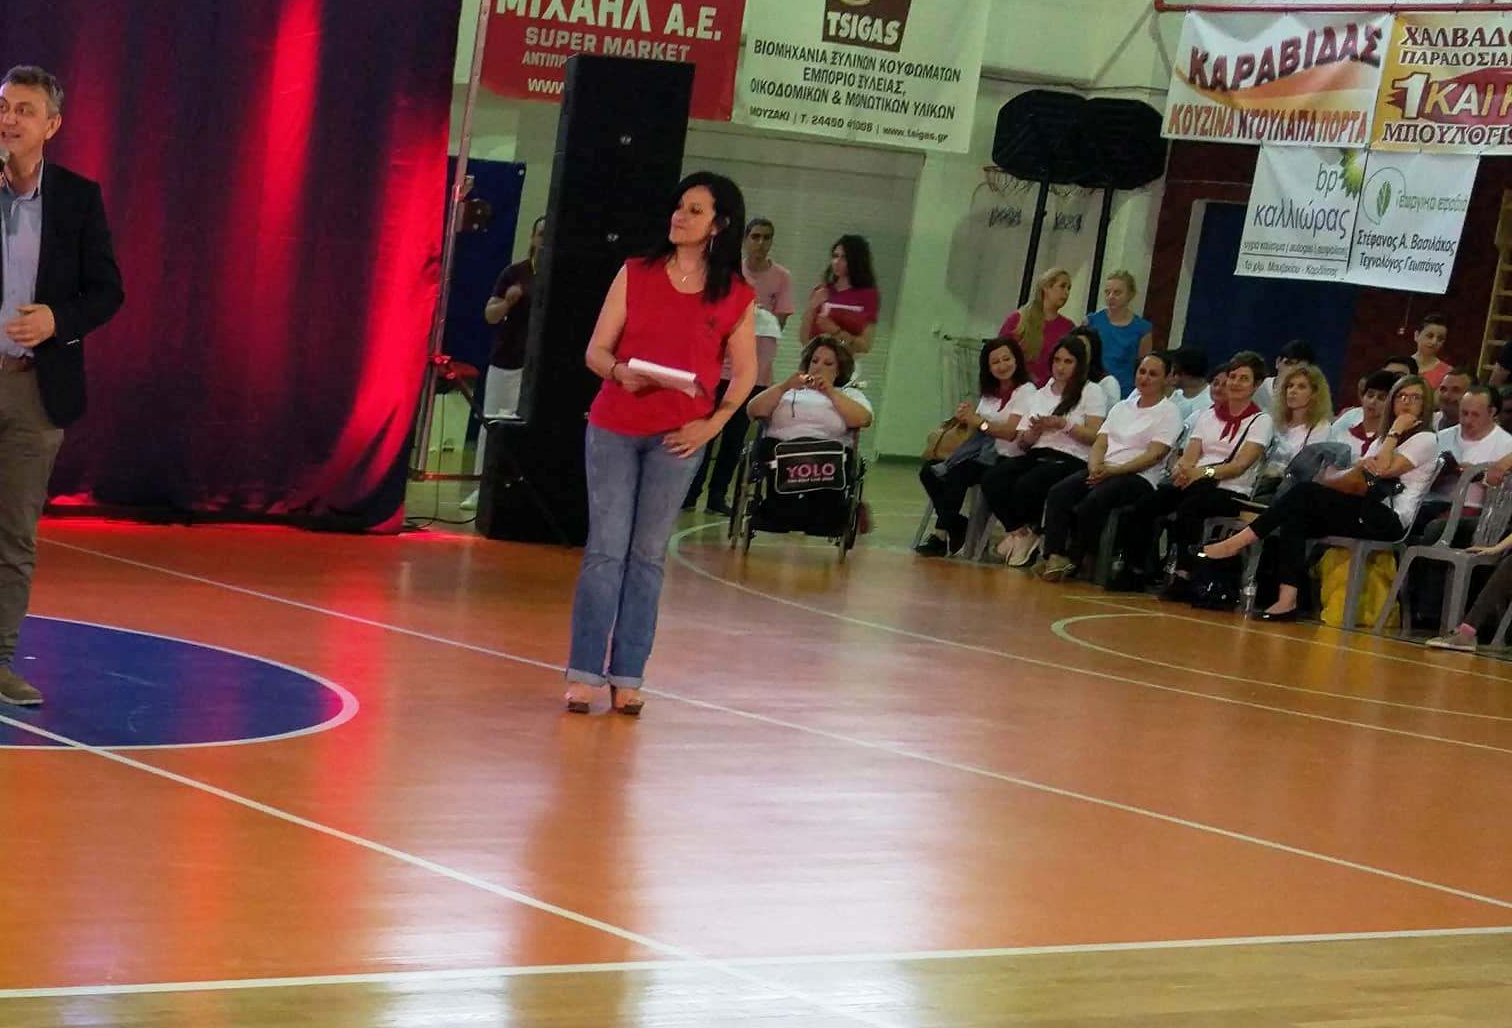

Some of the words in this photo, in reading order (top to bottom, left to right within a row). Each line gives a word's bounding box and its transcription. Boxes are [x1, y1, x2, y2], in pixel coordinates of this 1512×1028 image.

[663, 3, 722, 41] Α.Ε.
[826, 11, 901, 47] TSIGAS
[521, 50, 568, 69] ΑΝΤΙΠΡ
[525, 27, 596, 53] SUPER
[603, 36, 690, 63] MARKET
[754, 39, 828, 64] ΒΙΟΜΗΧΑΝΙΑ
[830, 50, 876, 71] ΞΥΛΙΝΩΝ
[879, 59, 961, 83] ΚΟΥΦΩΜΑΤΩΝ
[1188, 23, 1383, 92] ΚΑΡΑΒΙΔΑΣ
[1400, 50, 1512, 66] ΠΑΡΑΔΟΣΙΑ
[803, 67, 856, 87] ΕΜΠΟΡΙΟ
[750, 78, 828, 105] ΟΙΚΟΔΟΜΙΚΩΝ
[832, 91, 841, 105] &
[914, 98, 955, 120] ΥΛΙΚΩΝ
[1168, 104, 1234, 136] ΚΟΥΖΙΝΑ
[1317, 110, 1368, 143] ΠΟΡΤΑ
[1315, 163, 1338, 198] bp
[786, 463, 835, 478] YOLO
